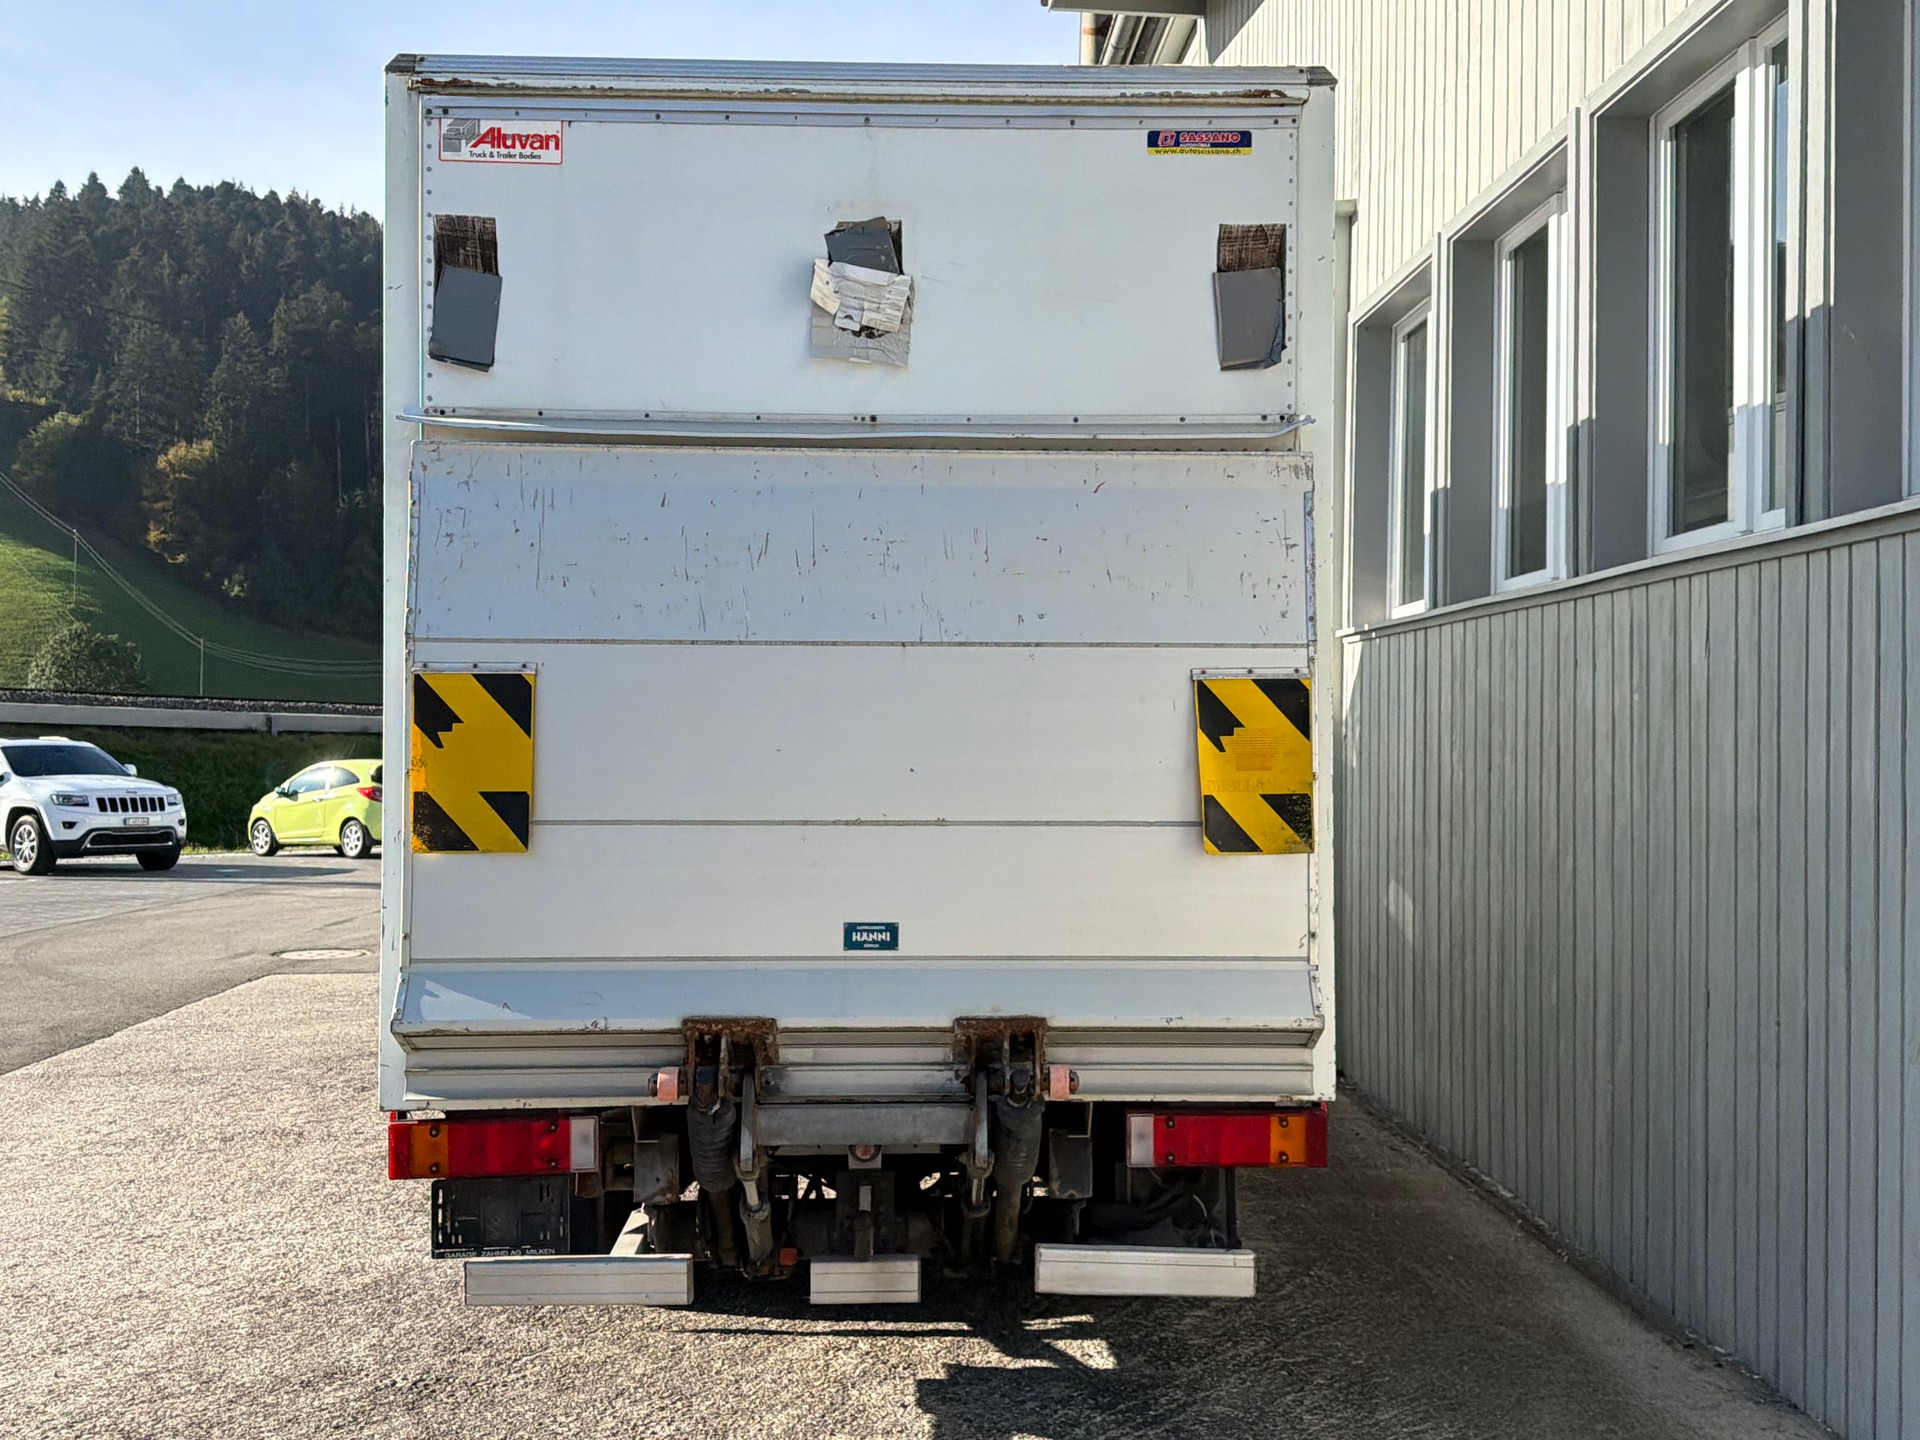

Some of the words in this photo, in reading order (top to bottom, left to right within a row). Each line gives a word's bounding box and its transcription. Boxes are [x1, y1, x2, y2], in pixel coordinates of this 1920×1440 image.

[469, 127, 560, 150] Aluvan
[1180, 132, 1241, 143] SASSANO
[469, 150, 485, 158] Truck
[496, 151, 517, 159] Trailer
[852, 931, 890, 941] HÄNNI
